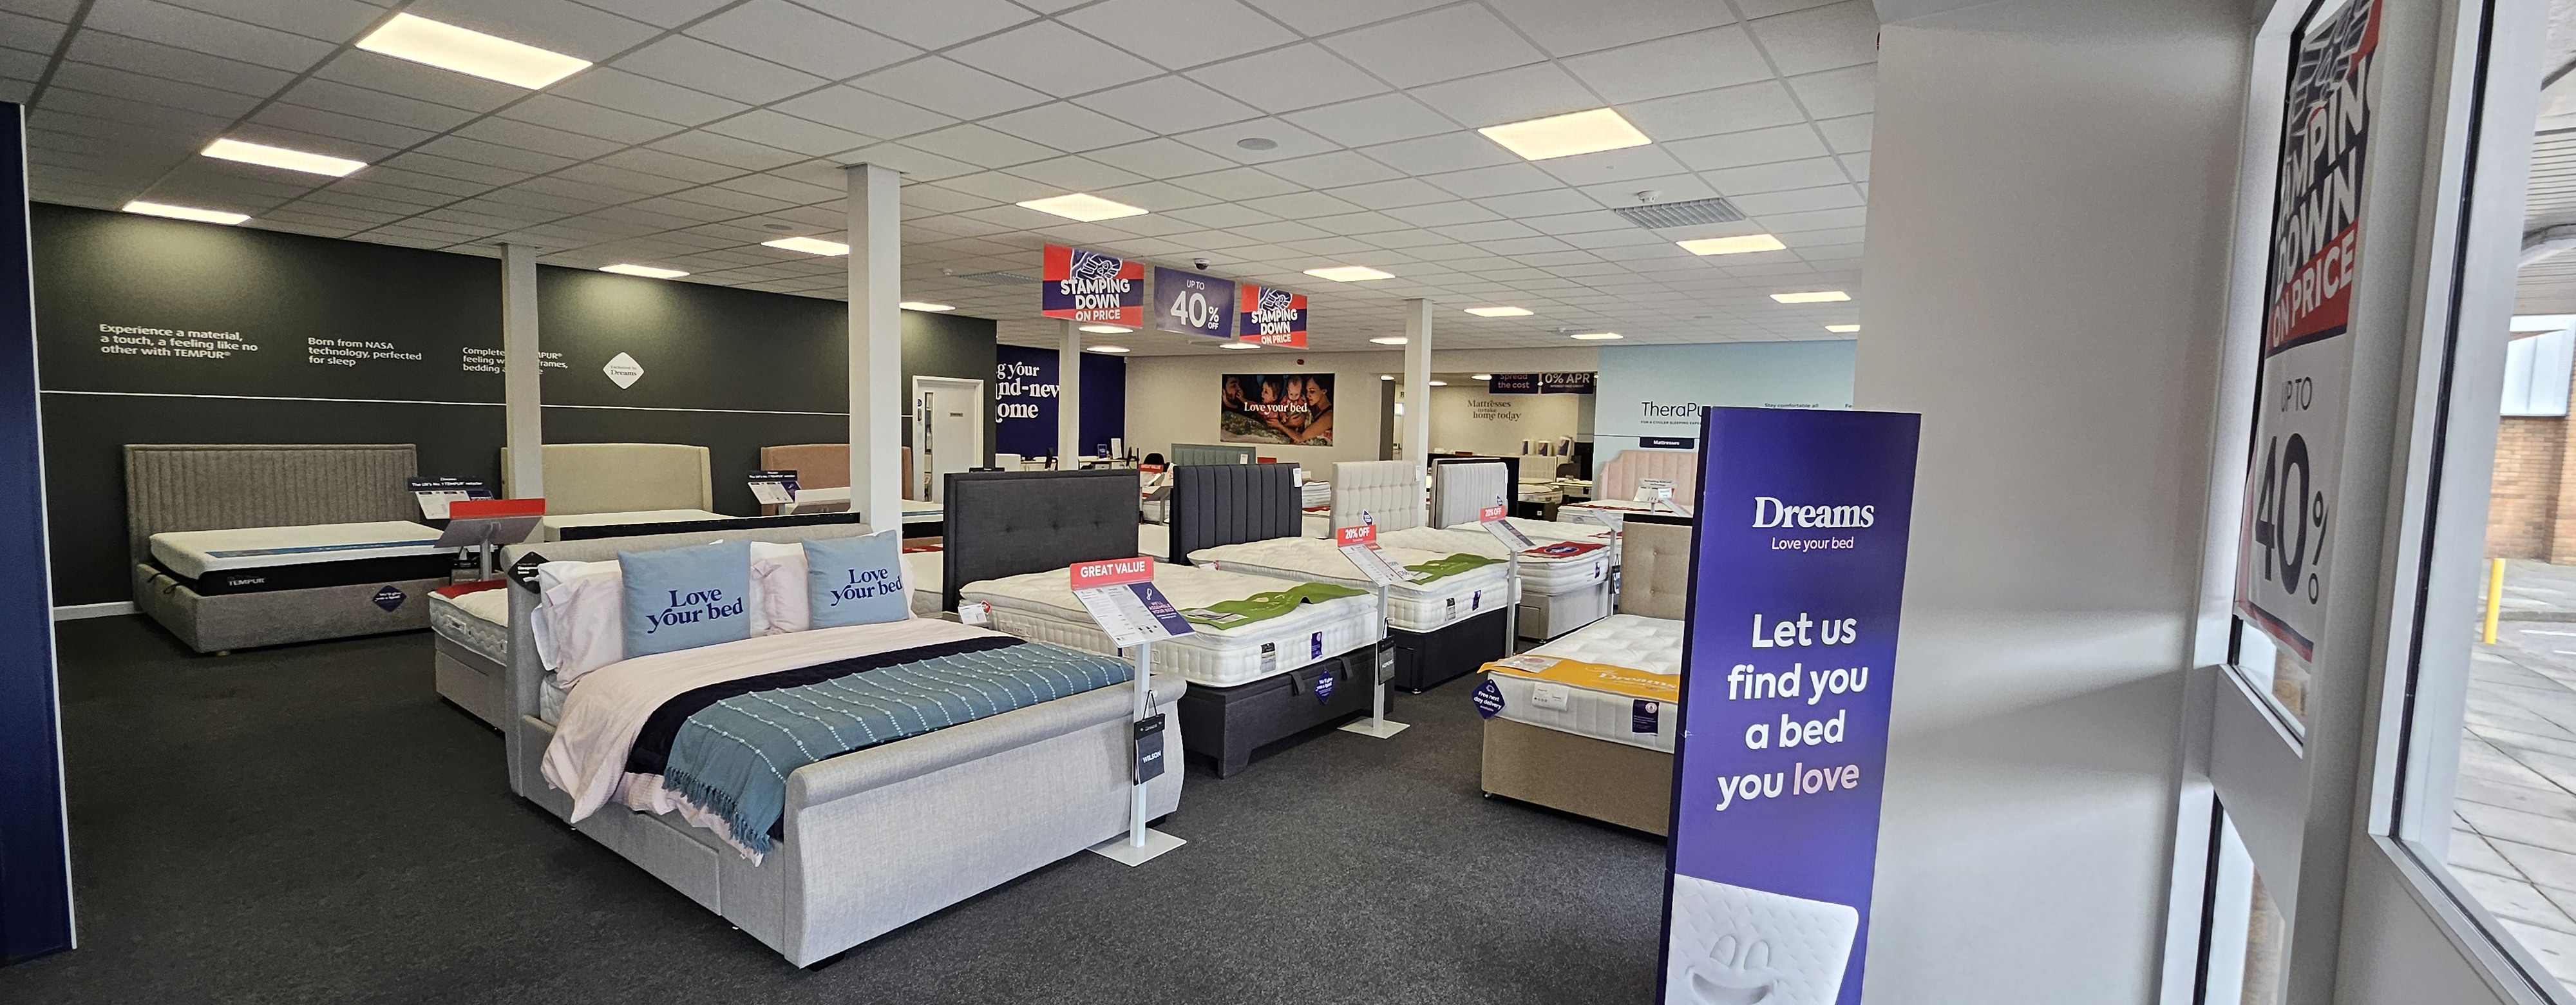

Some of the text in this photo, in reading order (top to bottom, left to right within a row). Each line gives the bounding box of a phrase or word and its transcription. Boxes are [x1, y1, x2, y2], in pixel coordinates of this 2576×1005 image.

[2275, 147, 2356, 305] DOWN
[1060, 278, 1130, 295] STAMPING
[1186, 279, 1205, 290] UP TO
[2273, 229, 2355, 348] ON PRICE
[1075, 294, 1121, 310] DOWN
[1075, 309, 1121, 321] ON PRICE
[1251, 309, 1298, 323] STAMPING
[99, 323, 173, 336] Experience
[187, 330, 243, 342] material,
[1260, 321, 1291, 336] DOWN
[112, 334, 155, 347] touch,
[158, 338, 167, 347] a
[170, 338, 214, 350] feeling
[217, 341, 240, 350] like
[242, 343, 259, 352] no
[308, 337, 395, 350] Born from NASA
[1260, 334, 1292, 345] ON PRICE
[100, 345, 138, 355] other
[140, 347, 171, 357] with
[308, 347, 422, 361] technology, perfected
[462, 347, 506, 358] Complete
[308, 355, 357, 368] for sleep
[462, 355, 495, 366] feeling
[462, 363, 500, 374] bedding
[1007, 361, 1041, 380] your
[1545, 373, 1564, 384] 0%
[1566, 373, 1591, 384] APR
[2280, 376, 2313, 413] UP TO
[1244, 401, 1308, 416] Love your bed
[1467, 399, 1511, 408] Mattresses
[1642, 401, 1702, 417] TheraPu
[996, 403, 1039, 422] ome
[1473, 411, 1522, 422] home today
[1752, 496, 1875, 529] Dreams
[1345, 526, 1370, 539] 20% OFF
[1772, 537, 1854, 552] Love your bed
[848, 567, 889, 585] Love
[1080, 560, 1146, 578] GREAT VALUE
[668, 587, 723, 609] Love
[829, 575, 904, 607] your bed
[645, 597, 744, 634] your bed
[1751, 612, 1857, 649] Let us
[1727, 662, 1869, 706] find you
[1473, 696, 1502, 710] day delivery
[1745, 709, 1846, 751] a bed
[1142, 750, 1162, 763] WILSON
[1715, 761, 1860, 812] you love
